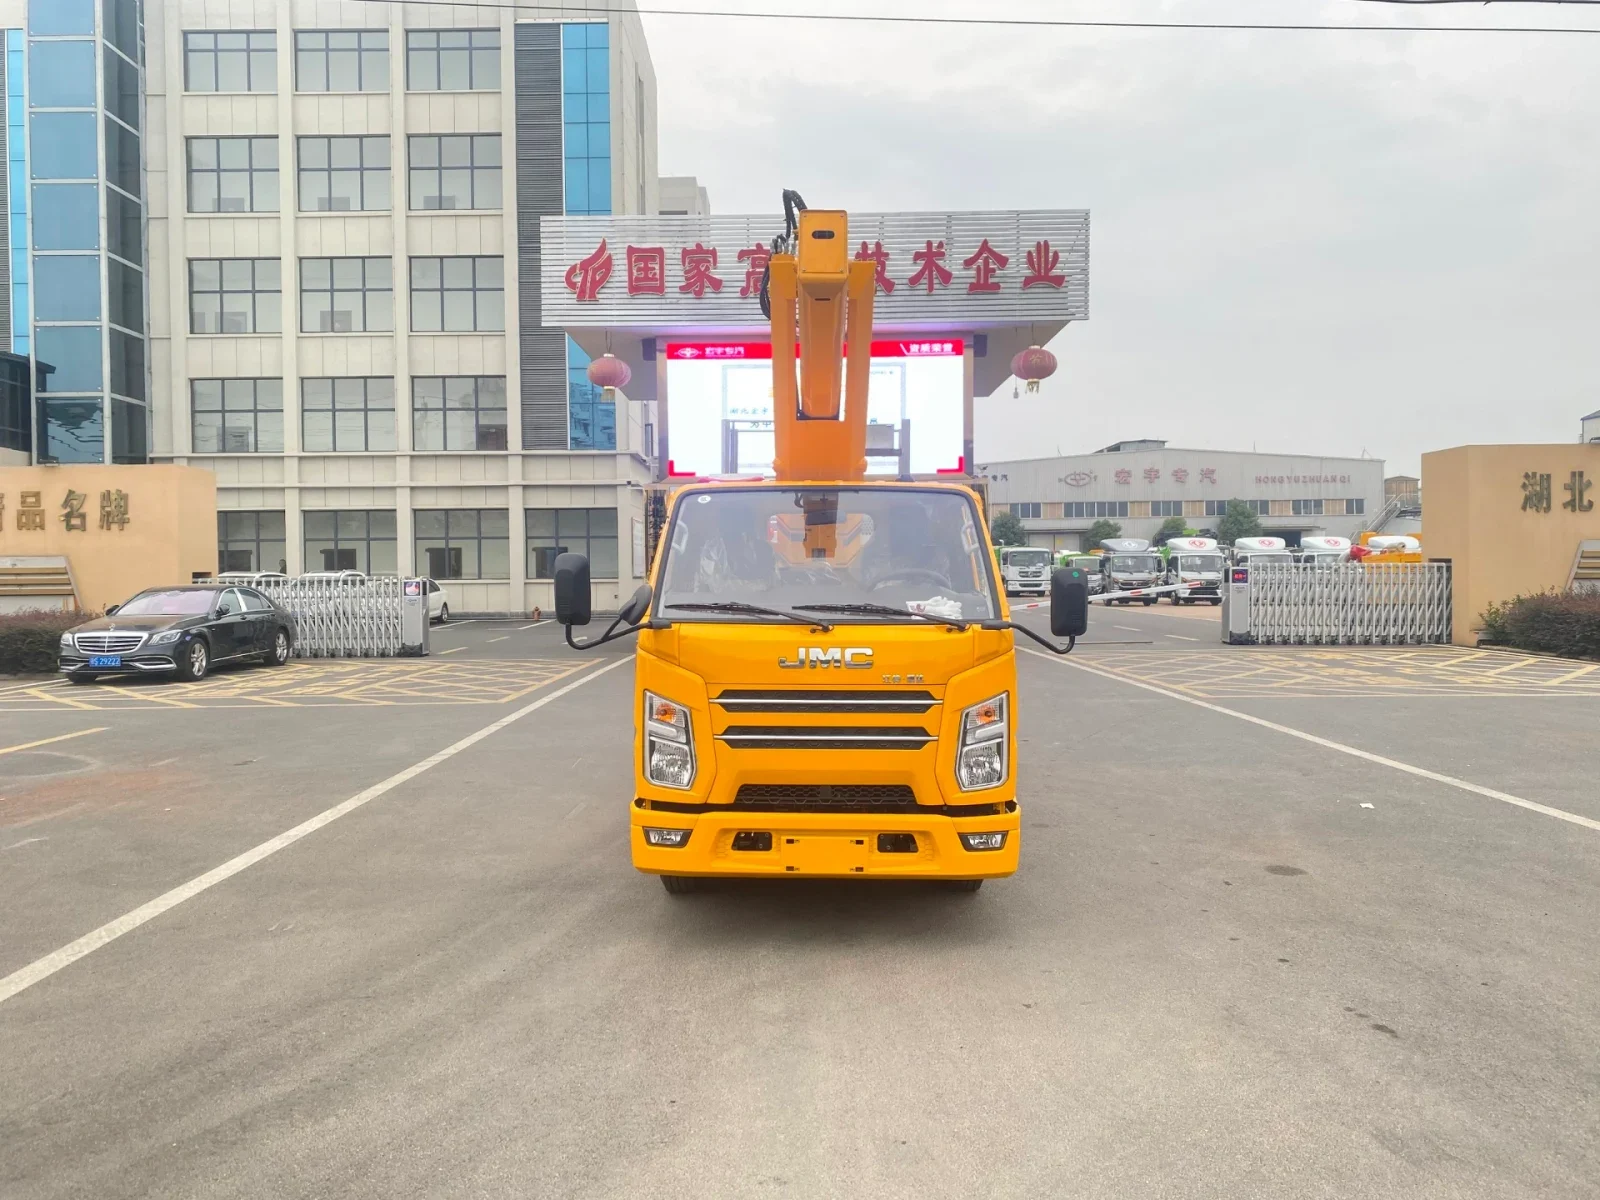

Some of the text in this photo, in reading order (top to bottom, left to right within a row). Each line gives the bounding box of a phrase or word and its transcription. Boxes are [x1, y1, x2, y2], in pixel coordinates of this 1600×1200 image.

[626, 238, 1065, 298] 国家高技术企业
[1114, 467, 1217, 484] 宏宇专汽
[1521, 471, 1594, 513] 湖北
[0, 489, 130, 531] 品名牌
[778, 647, 873, 669] JMC
